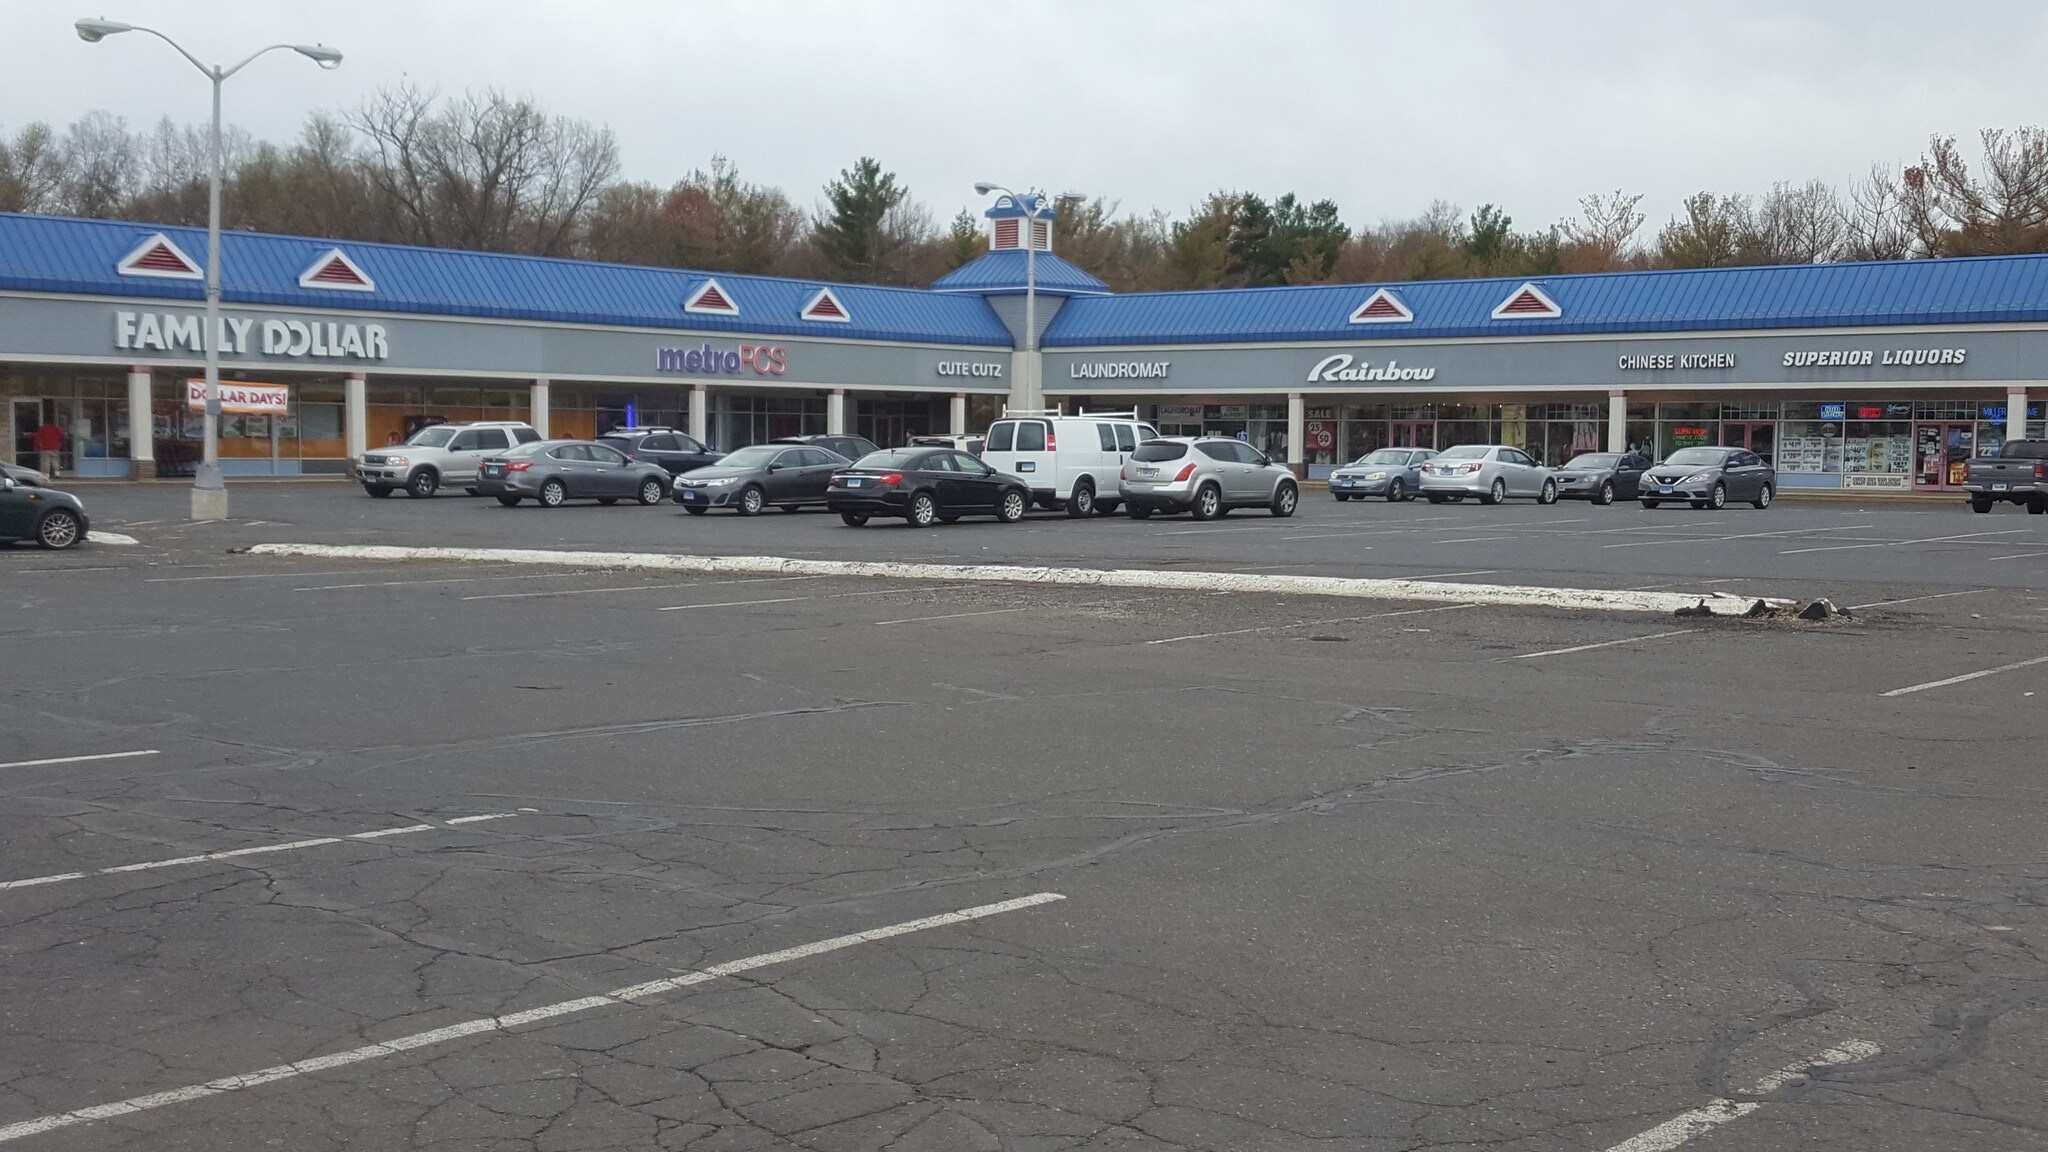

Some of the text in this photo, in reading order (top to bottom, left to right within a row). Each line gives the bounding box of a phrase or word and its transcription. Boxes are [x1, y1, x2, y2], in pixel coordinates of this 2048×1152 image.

[262, 319, 389, 359] DOLLAR
[656, 343, 788, 375] metroPCS
[1619, 353, 1735, 369] CHINESE KITCHEN
[1782, 349, 1966, 367] SUPERIOR LIQUORS
[938, 361, 1002, 377] CUTE CUTZ
[1071, 362, 1170, 379] LAUNDROMAT
[1306, 354, 1435, 381] Rainbow
[250, 392, 286, 405] DAYS!
[1308, 409, 1332, 419] SALE
[1983, 407, 2007, 416] MILLER
[1319, 434, 1330, 443] 50
